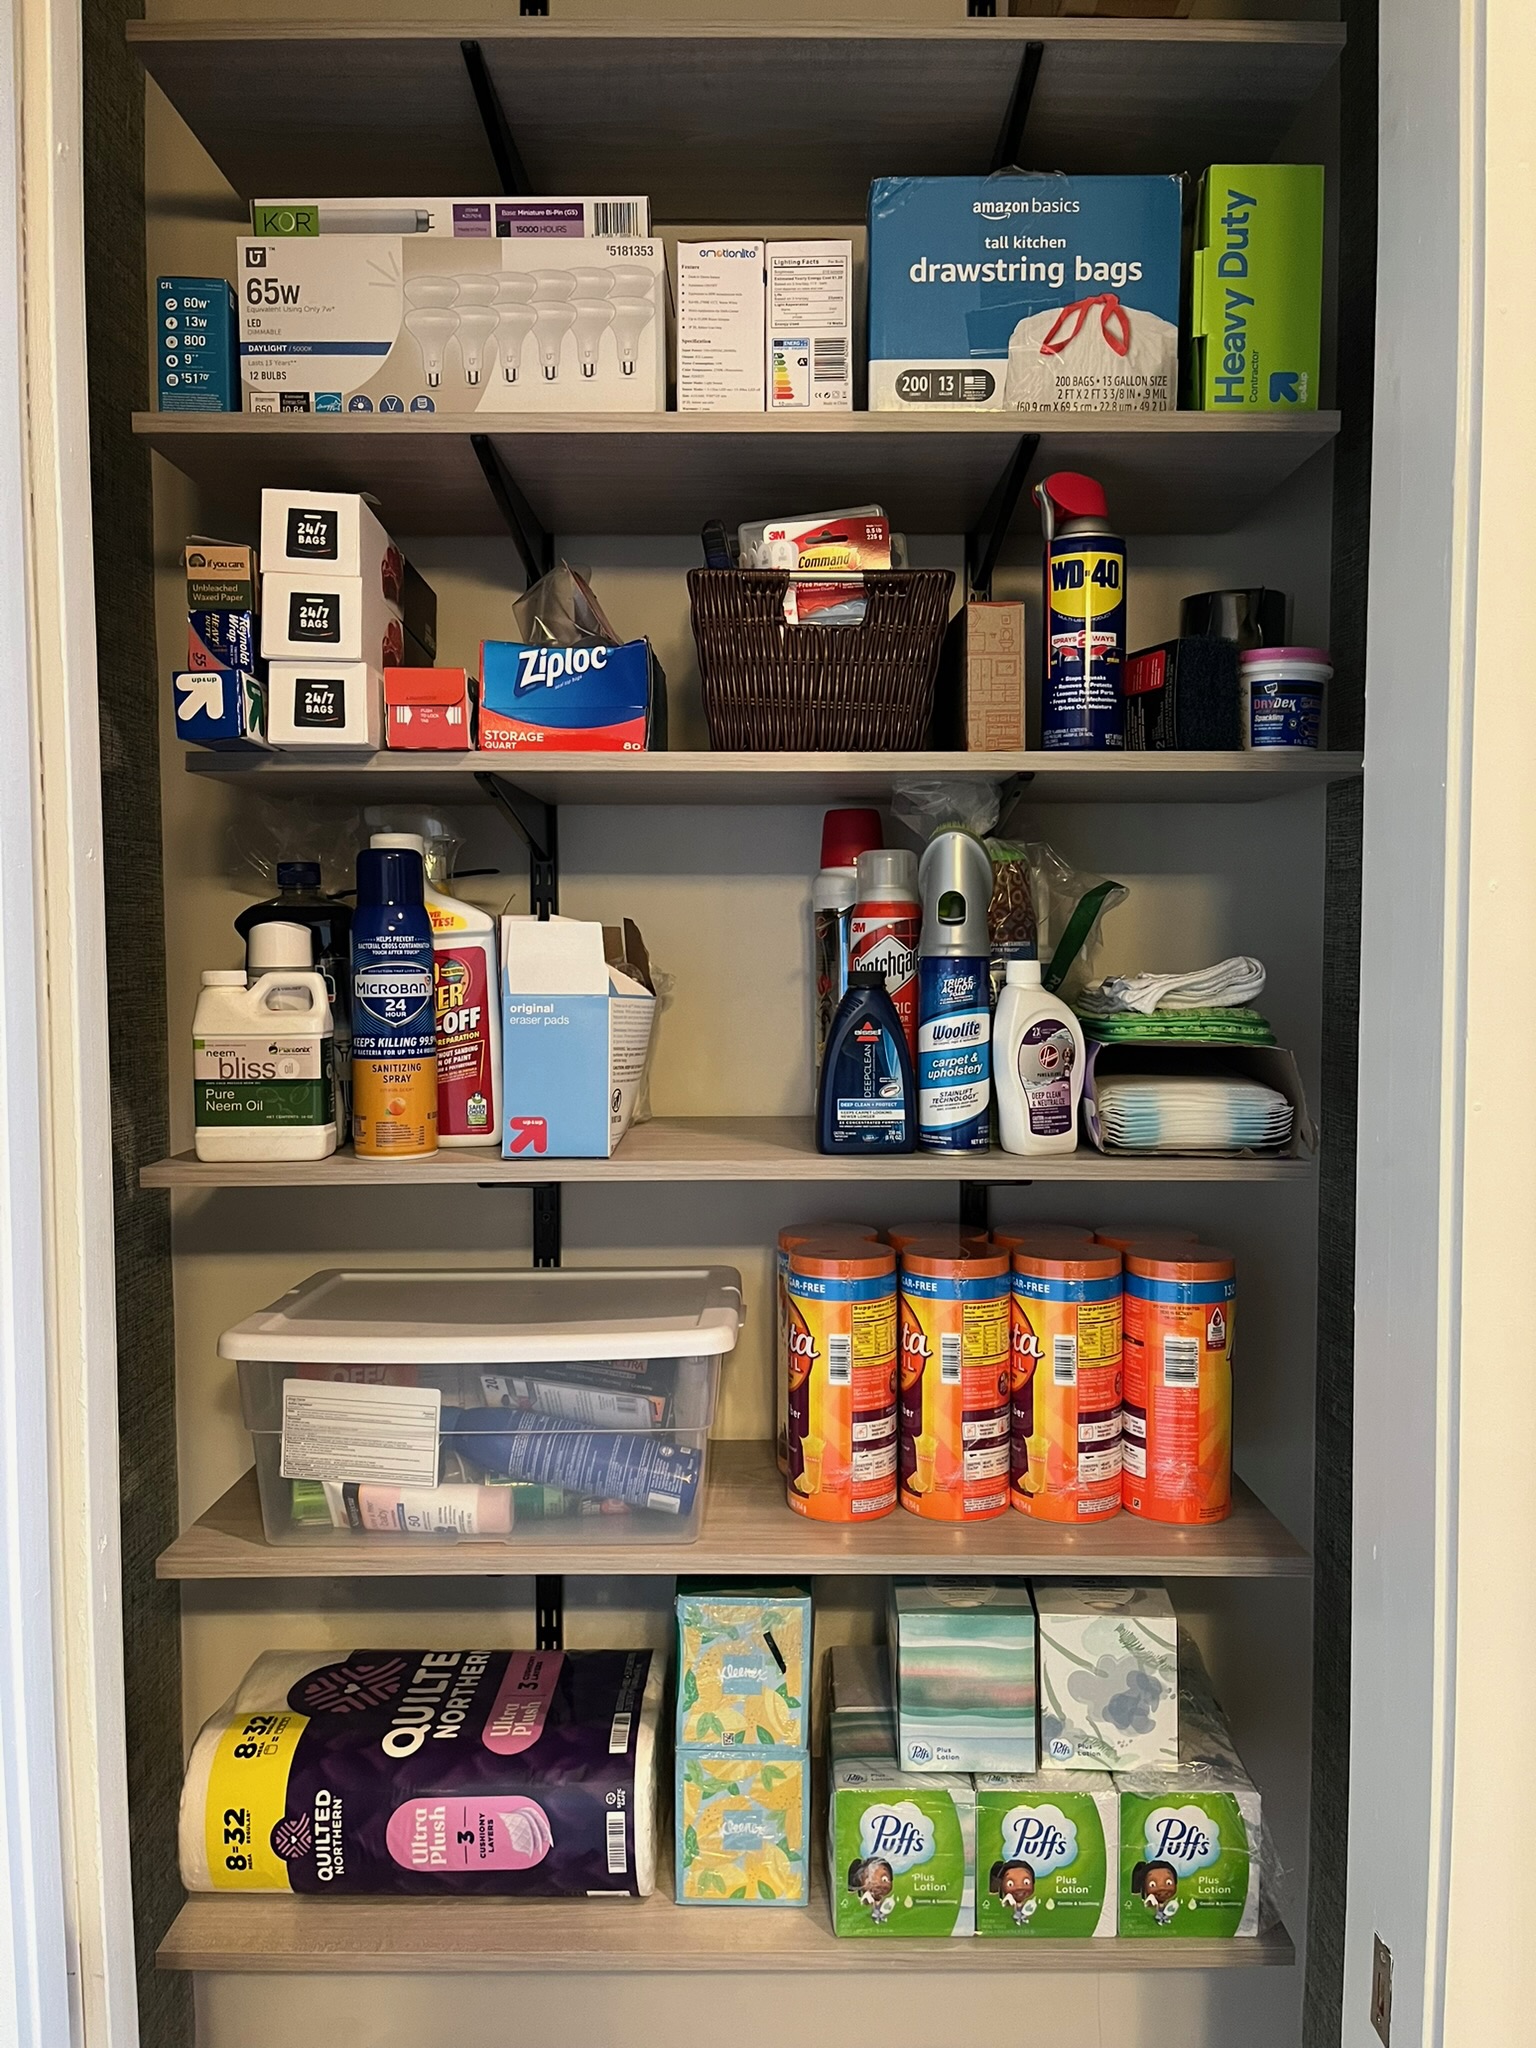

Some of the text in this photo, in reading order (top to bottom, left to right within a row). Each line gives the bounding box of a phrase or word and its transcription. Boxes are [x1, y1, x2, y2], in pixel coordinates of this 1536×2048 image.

[973, 198, 1080, 215] amazon basics
[263, 212, 311, 233] KOR
[516, 225, 567, 233] 15000 HOURS
[984, 235, 1067, 249] tall kitchen
[606, 245, 654, 256] #5181353
[909, 255, 1143, 287] drawstring bags
[160, 282, 173, 290] CFL
[1214, 189, 1258, 403] Heavy Duty
[246, 305, 320, 313] Equivalent Using Only
[247, 318, 261, 327] LED
[184, 335, 206, 346] 800
[248, 359, 264, 367] Lasts
[249, 371, 287, 380] 12 BULBS
[1055, 375, 1167, 387] 200 BAGS 13 GALLON SIZE
[1249, 350, 1259, 403] Contractor
[902, 376, 928, 392] 200
[938, 376, 955, 392] 13
[1057, 388, 1167, 399] 2 FT X 2 FT 3 3/8 IN MIL
[297, 522, 328, 536] 24/7
[298, 535, 327, 546] BAGS
[768, 531, 786, 540] 3M
[207, 559, 213, 567] if
[212, 561, 228, 570] you
[798, 552, 850, 569] Command
[1051, 559, 1120, 591] WD-40
[192, 584, 238, 592] Unbleached
[192, 593, 244, 603] Waxed Paper
[299, 606, 330, 620] 24/7
[211, 612, 220, 645] HEAVY
[226, 613, 239, 643] Wrap
[300, 618, 329, 629] BAGS
[237, 616, 250, 666] Reynolds
[1053, 636, 1077, 645] SPRAYS
[192, 652, 207, 668] 55
[518, 645, 609, 688] Ziploc
[304, 692, 335, 706] 24/7
[1254, 697, 1297, 712] DRYDex
[306, 704, 334, 715] BAGS
[1254, 714, 1285, 722] Spackling
[484, 730, 545, 743] STORAGE
[484, 741, 517, 750] QUART
[623, 742, 641, 751] 80
[852, 922, 866, 933] 3M
[943, 975, 974, 987] TRIPLE
[356, 982, 427, 995] MICROBAN
[941, 982, 974, 994] ACTION
[385, 998, 407, 1011] 24
[510, 1003, 554, 1015] original
[510, 1015, 570, 1026] eraser pads
[932, 1020, 980, 1041] Woolite
[1032, 1027, 1042, 1037] 2X
[378, 1037, 418, 1048] KILLING
[454, 1045, 479, 1057] SANDING
[453, 1053, 472, 1065] PAINT
[932, 1052, 978, 1068] carpet &
[219, 1057, 277, 1079] bliss
[284, 1063, 293, 1074] oil
[372, 1063, 422, 1073] SANITIZING
[863, 1044, 872, 1098] DEEPCLEAN
[927, 1063, 983, 1080] upholstery
[383, 1075, 412, 1083] SPRAY
[206, 1088, 235, 1099] Pure
[940, 1087, 973, 1097] STAINLIFT
[1046, 1091, 1061, 1099] CLEAN
[932, 1094, 976, 1104] TECHNOLOGY
[1037, 1098, 1066, 1107] NEUTRALIZE
[205, 1100, 263, 1111] Neem Oil
[853, 1301, 890, 1311] Supplement
[1079, 1304, 1116, 1312] Supplement
[408, 1515, 420, 1527] 50
[522, 1656, 536, 1680] CUSHIONY
[532, 1661, 543, 1680] LAYERS
[717, 1660, 768, 1682] Kleenex
[490, 1703, 520, 1737] Ultra
[511, 1701, 542, 1736] Plush
[911, 1745, 930, 1761] Puffs
[1052, 1741, 1070, 1758] Puffs
[718, 1818, 768, 1838] Kleenex
[314, 1789, 334, 1881] QUILTED
[332, 1797, 345, 1875] NORTHERN
[412, 1808, 428, 1865] Ultra
[429, 1806, 447, 1865] Plush
[457, 1830, 475, 1845] 3
[479, 1813, 487, 1859] CUSHIONY
[871, 1815, 925, 1857] Puffs
[1013, 1818, 1067, 1860] Puffs
[1156, 1818, 1210, 1861] Puffs
[914, 1873, 935, 1882] Plus
[1056, 1876, 1077, 1885] Plus
[1199, 1876, 1220, 1885] Plus
[914, 1882, 946, 1891] Lotion
[1056, 1885, 1088, 1894] Lotion
[1199, 1885, 1231, 1894] Lotion
